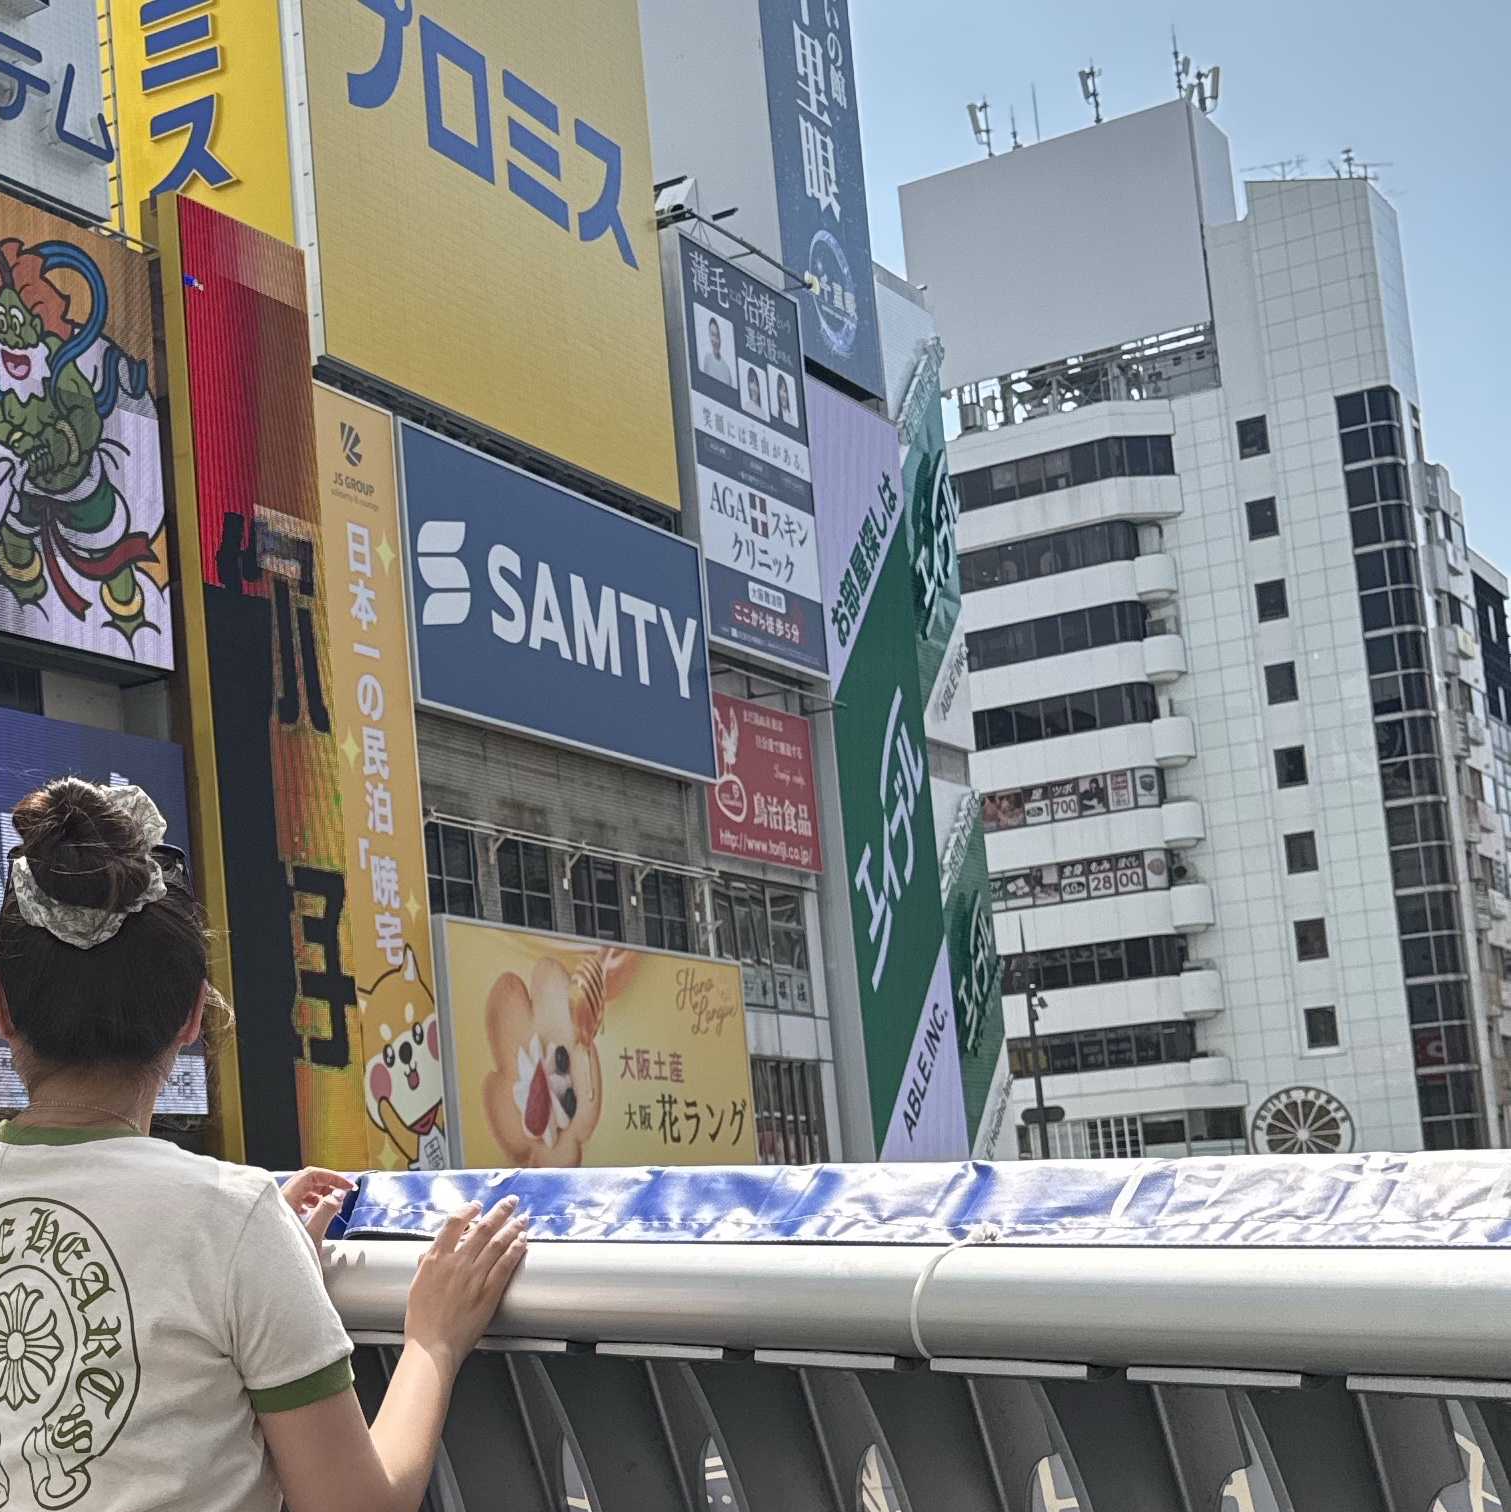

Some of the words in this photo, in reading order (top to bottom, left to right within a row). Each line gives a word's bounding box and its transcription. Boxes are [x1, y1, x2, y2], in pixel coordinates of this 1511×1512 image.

[333, 472, 344, 487] JS
[345, 475, 375, 497] GROUP
[710, 481, 749, 525] AGA
[771, 510, 809, 548] スキン
[732, 532, 794, 583] クリニック
[831, 470, 898, 648] お部屋探しは
[488, 544, 698, 700] SAMTY
[855, 686, 924, 993] エイブル
[619, 1047, 685, 1084] 大阪土産
[624, 1103, 653, 1131] 大阪
[656, 1093, 747, 1147] 花ラング
